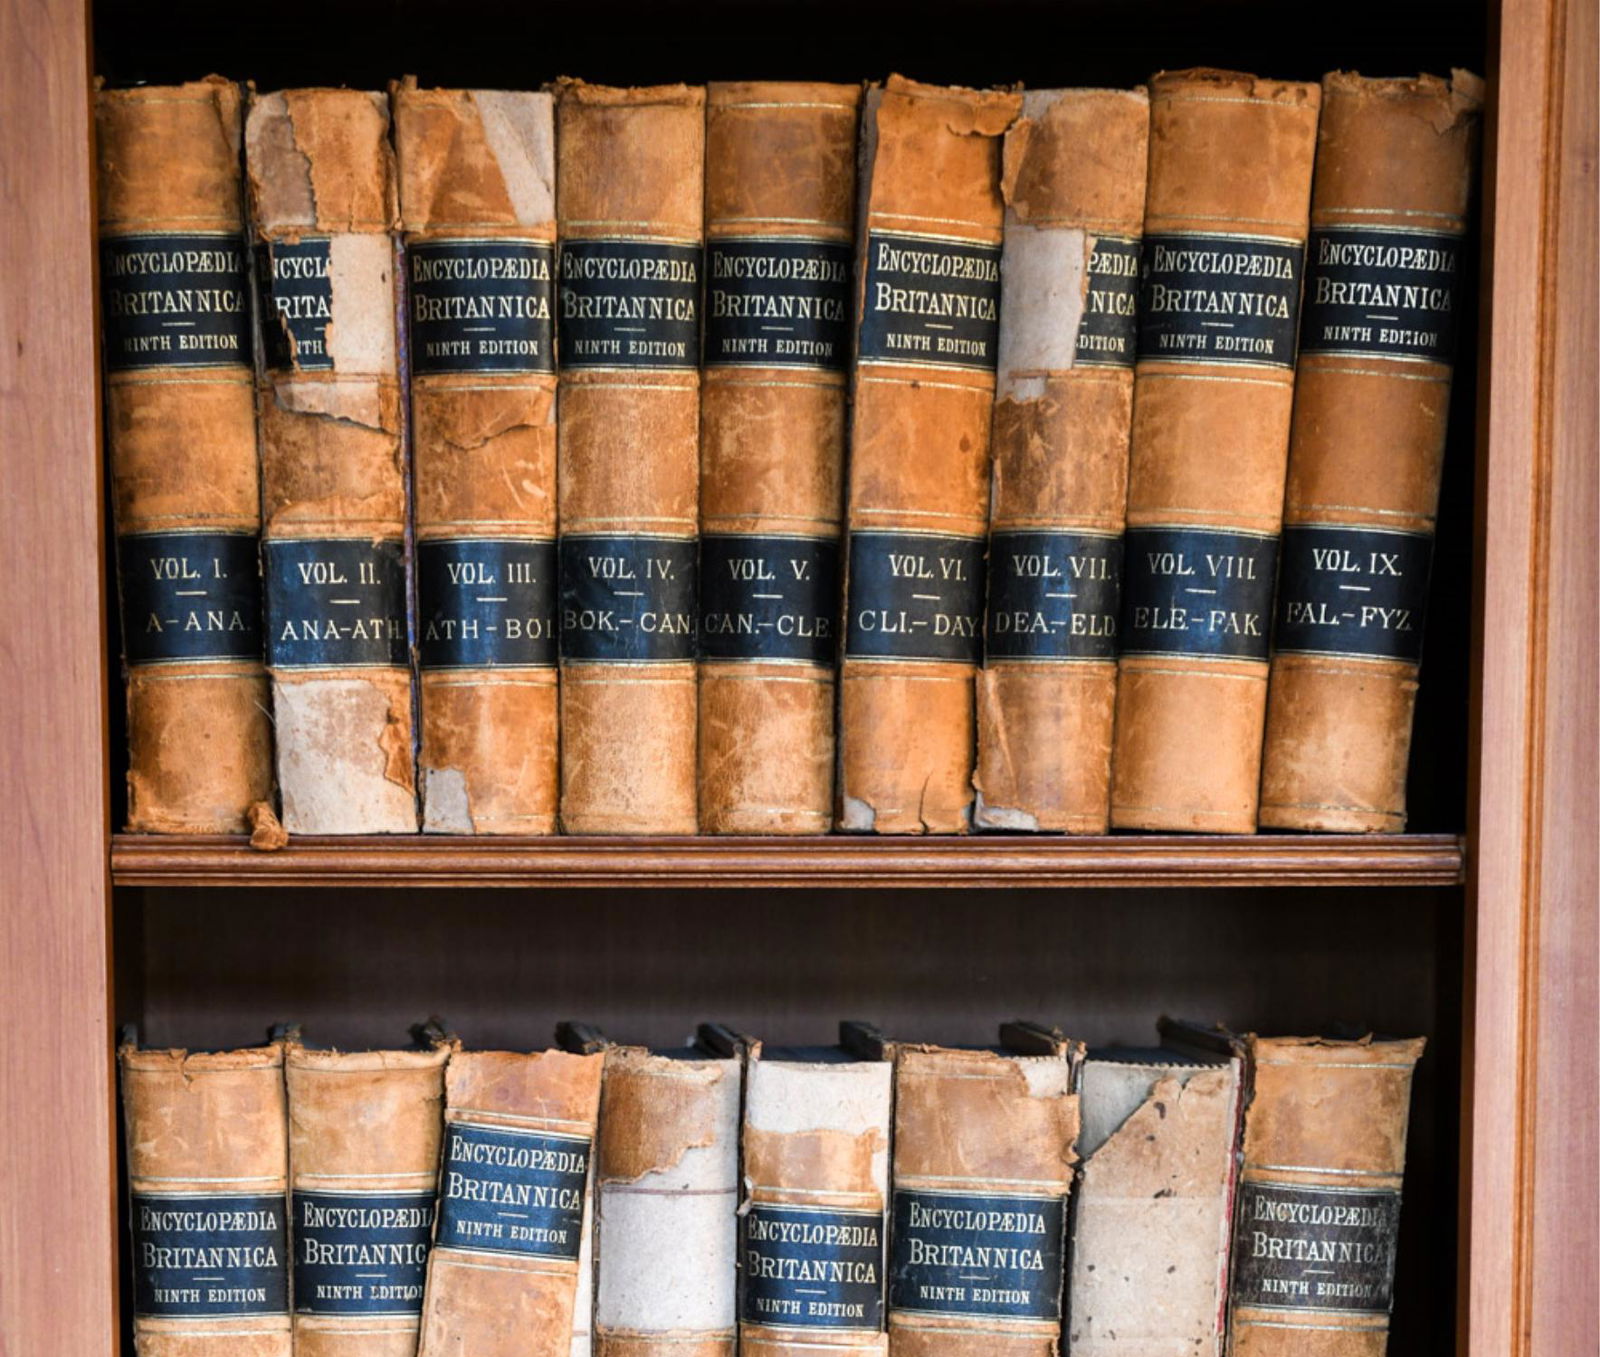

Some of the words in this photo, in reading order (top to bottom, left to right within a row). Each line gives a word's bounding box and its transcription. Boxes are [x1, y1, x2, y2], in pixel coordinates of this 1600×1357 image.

[413, 255, 550, 281] ENCYCLOPÆDIA
[563, 253, 697, 283] ENCYCLOPÆDIA
[713, 251, 847, 283] ENCYCLOPÆDIA
[877, 242, 999, 282] ENCYCLOPÆDIA
[1153, 245, 1294, 280] ENCYCLOPÆDIA
[1318, 238, 1455, 272] ENCYCLOPÆDIA
[274, 295, 332, 319] RITA
[415, 294, 550, 321] BRITANNICA
[563, 289, 695, 322] BRITANNICA
[713, 290, 844, 322] BRITANNICA
[875, 282, 997, 321] BRITANNICA
[1151, 284, 1290, 319] BRITANNICA
[1316, 277, 1452, 311] BRITANNICA
[124, 335, 171, 352] NINTH
[179, 334, 238, 350] EDITION
[427, 340, 471, 357] NINTH
[479, 340, 538, 355] EDITION
[575, 340, 621, 356] NINTH
[629, 340, 686, 358] EDITION
[722, 338, 768, 354] NINTH
[776, 340, 833, 357] EDITION
[886, 333, 930, 351] NINTH
[937, 336, 986, 357] EDITION
[1075, 334, 1125, 353] DITION
[1159, 333, 1207, 350] NINTH
[1215, 336, 1274, 354] EDITION
[1324, 325, 1371, 342] NINTH
[1379, 328, 1438, 347] EDITION
[150, 558, 201, 579] VOL.
[213, 558, 228, 579] I.
[298, 562, 348, 585] VOL.
[359, 562, 381, 585] II.
[447, 562, 496, 585] VOL.
[507, 562, 536, 583] III.
[588, 556, 636, 579] VOL.
[646, 558, 675, 580] IV.
[728, 559, 776, 580] VOL.
[790, 559, 810, 581] V.
[888, 554, 934, 579] VOL.
[940, 557, 967, 582] VI.
[1013, 554, 1061, 578] VOL.
[1069, 556, 1112, 580] VII.
[1148, 552, 1195, 575] VOL.
[1206, 554, 1256, 580] VIII.
[1312, 548, 1360, 573] VOL.
[1369, 552, 1402, 576] IX.
[451, 1134, 586, 1174] ENCYCLOPÆDIA
[447, 1171, 581, 1211] BRITANNICA
[140, 1205, 277, 1232] ENCYCLOPÆDIA
[909, 1202, 1047, 1235] ENCYCLOPÆDIA
[1253, 1194, 1388, 1228] ENCYCLOPÆDIA
[456, 1219, 503, 1238] NINTH
[510, 1225, 567, 1244] EDITION
[748, 1213, 878, 1247] ENCYCLOPÆDIA
[142, 1242, 278, 1268] BRITANNICA
[304, 1237, 426, 1265] BRITANNIC
[909, 1238, 1044, 1271] BRITANNICA
[1252, 1231, 1386, 1264] BRITANNICA
[748, 1250, 877, 1284] BRITANNICA
[154, 1287, 200, 1303] NINTH
[208, 1287, 266, 1302] EDITION
[316, 1284, 363, 1300] NINTH
[920, 1285, 965, 1302] NINTH
[972, 1287, 1031, 1305] EDITION
[1261, 1279, 1309, 1295] NINTH
[1316, 1282, 1373, 1298] EDITION
[756, 1298, 801, 1315] NINTH
[808, 1300, 864, 1318] EDITION
